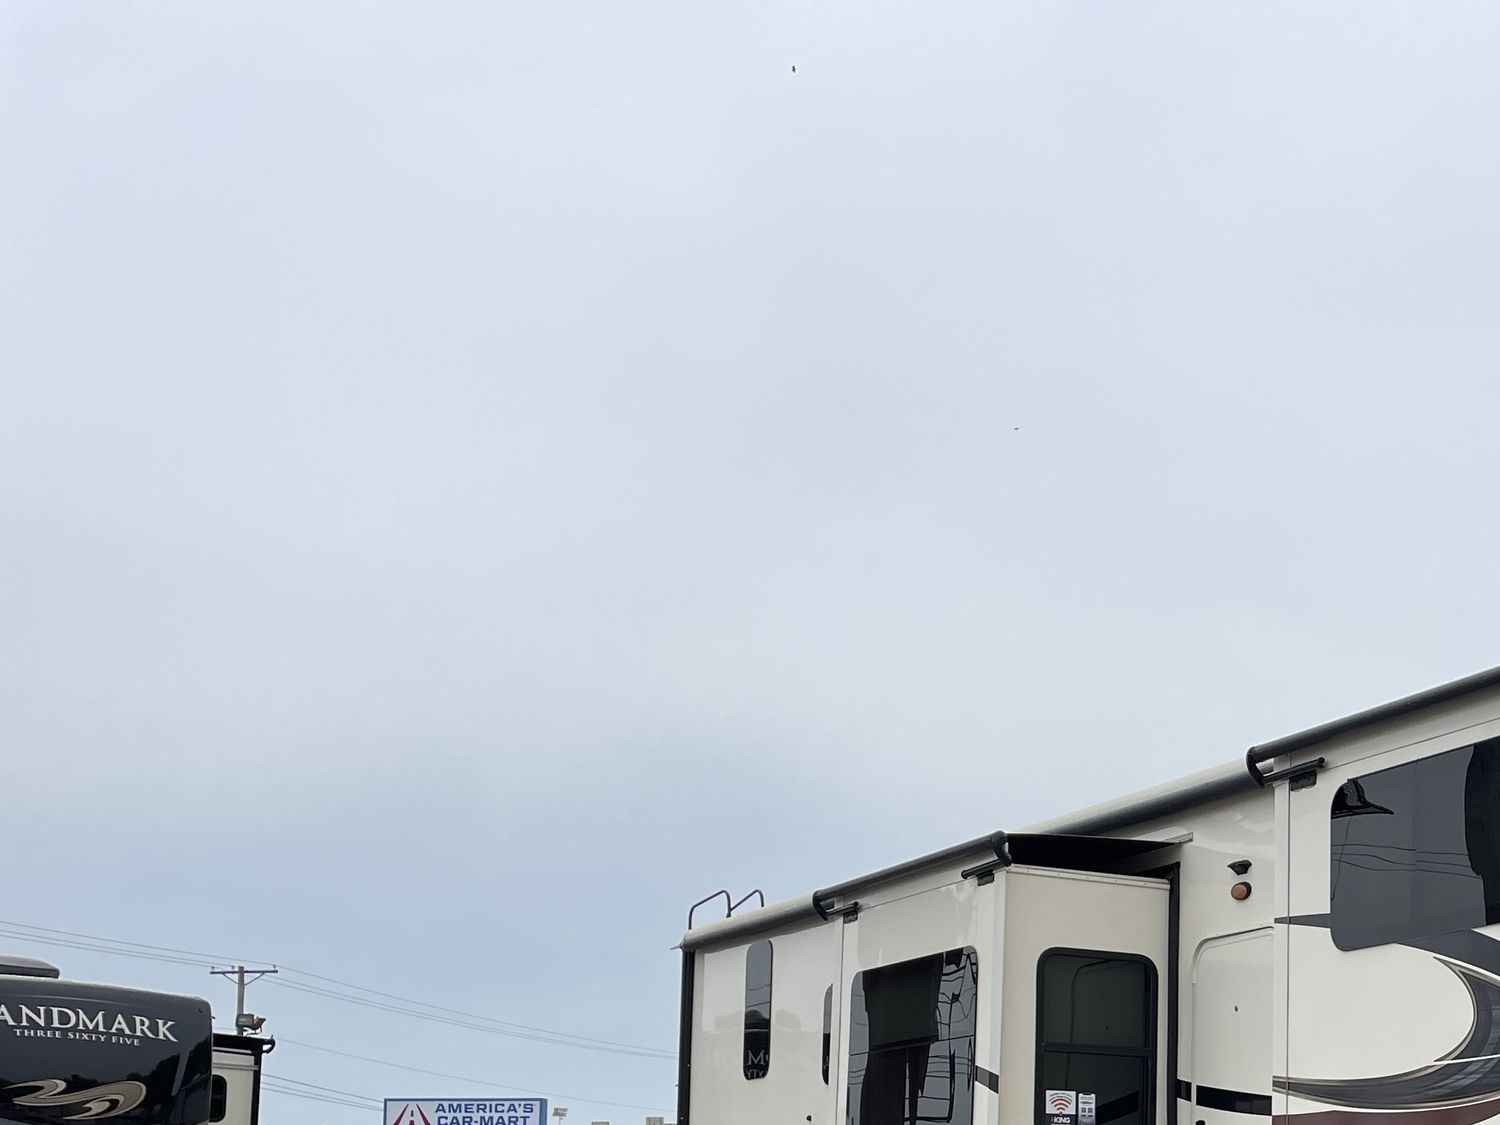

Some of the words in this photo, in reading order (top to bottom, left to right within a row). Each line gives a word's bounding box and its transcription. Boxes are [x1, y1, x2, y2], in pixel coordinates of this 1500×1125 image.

[13, 1028, 62, 1039] THREE
[67, 1031, 107, 1043] SIXTY
[112, 1036, 140, 1047] FIVE
[434, 1103, 534, 1114] AMERICA'S
